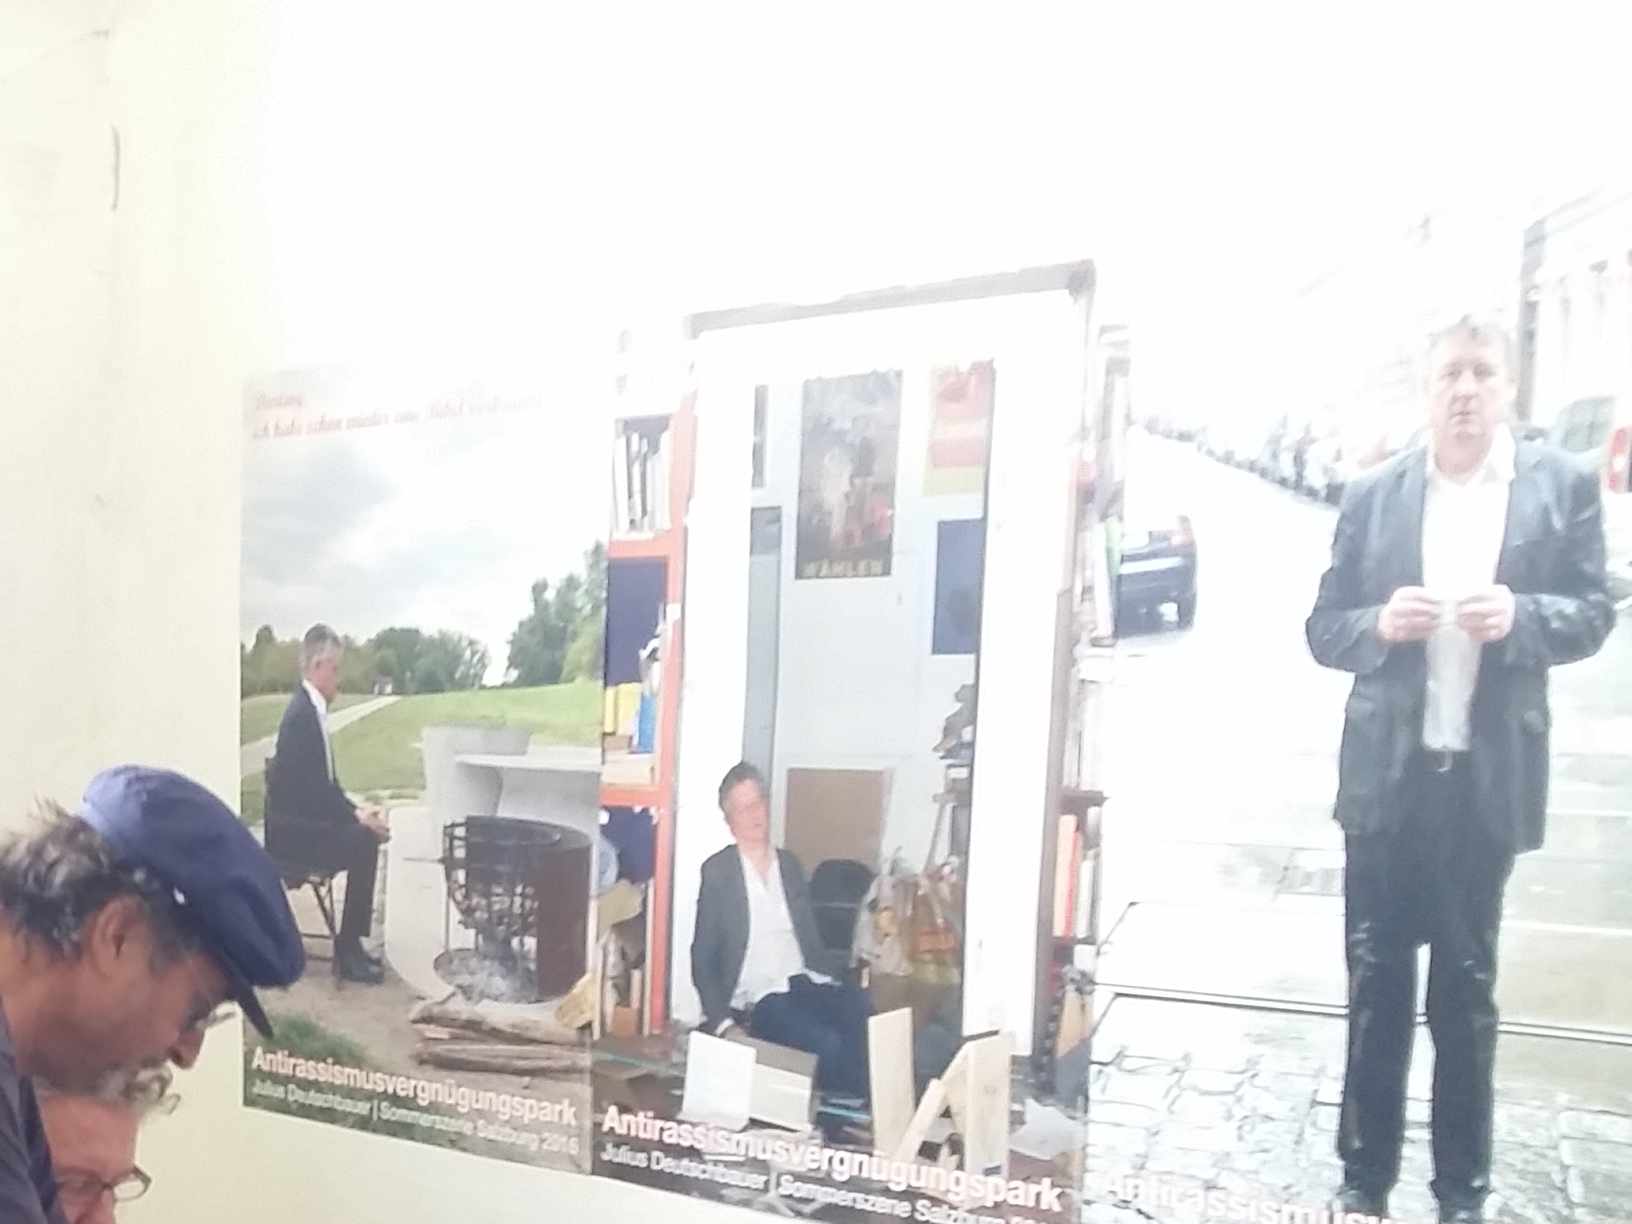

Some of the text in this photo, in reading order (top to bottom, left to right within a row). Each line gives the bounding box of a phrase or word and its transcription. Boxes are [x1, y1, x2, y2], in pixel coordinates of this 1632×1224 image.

[251, 1045, 577, 1126] Antirassismusvergnügungspark
[540, 1132, 580, 1156] 2016
[600, 1141, 649, 1169] Julius
[650, 1150, 769, 1190] Deutschbauer
[778, 1173, 912, 1218] Sommerszene
[601, 1104, 1064, 1213] Antirassismusvergnügungspark
